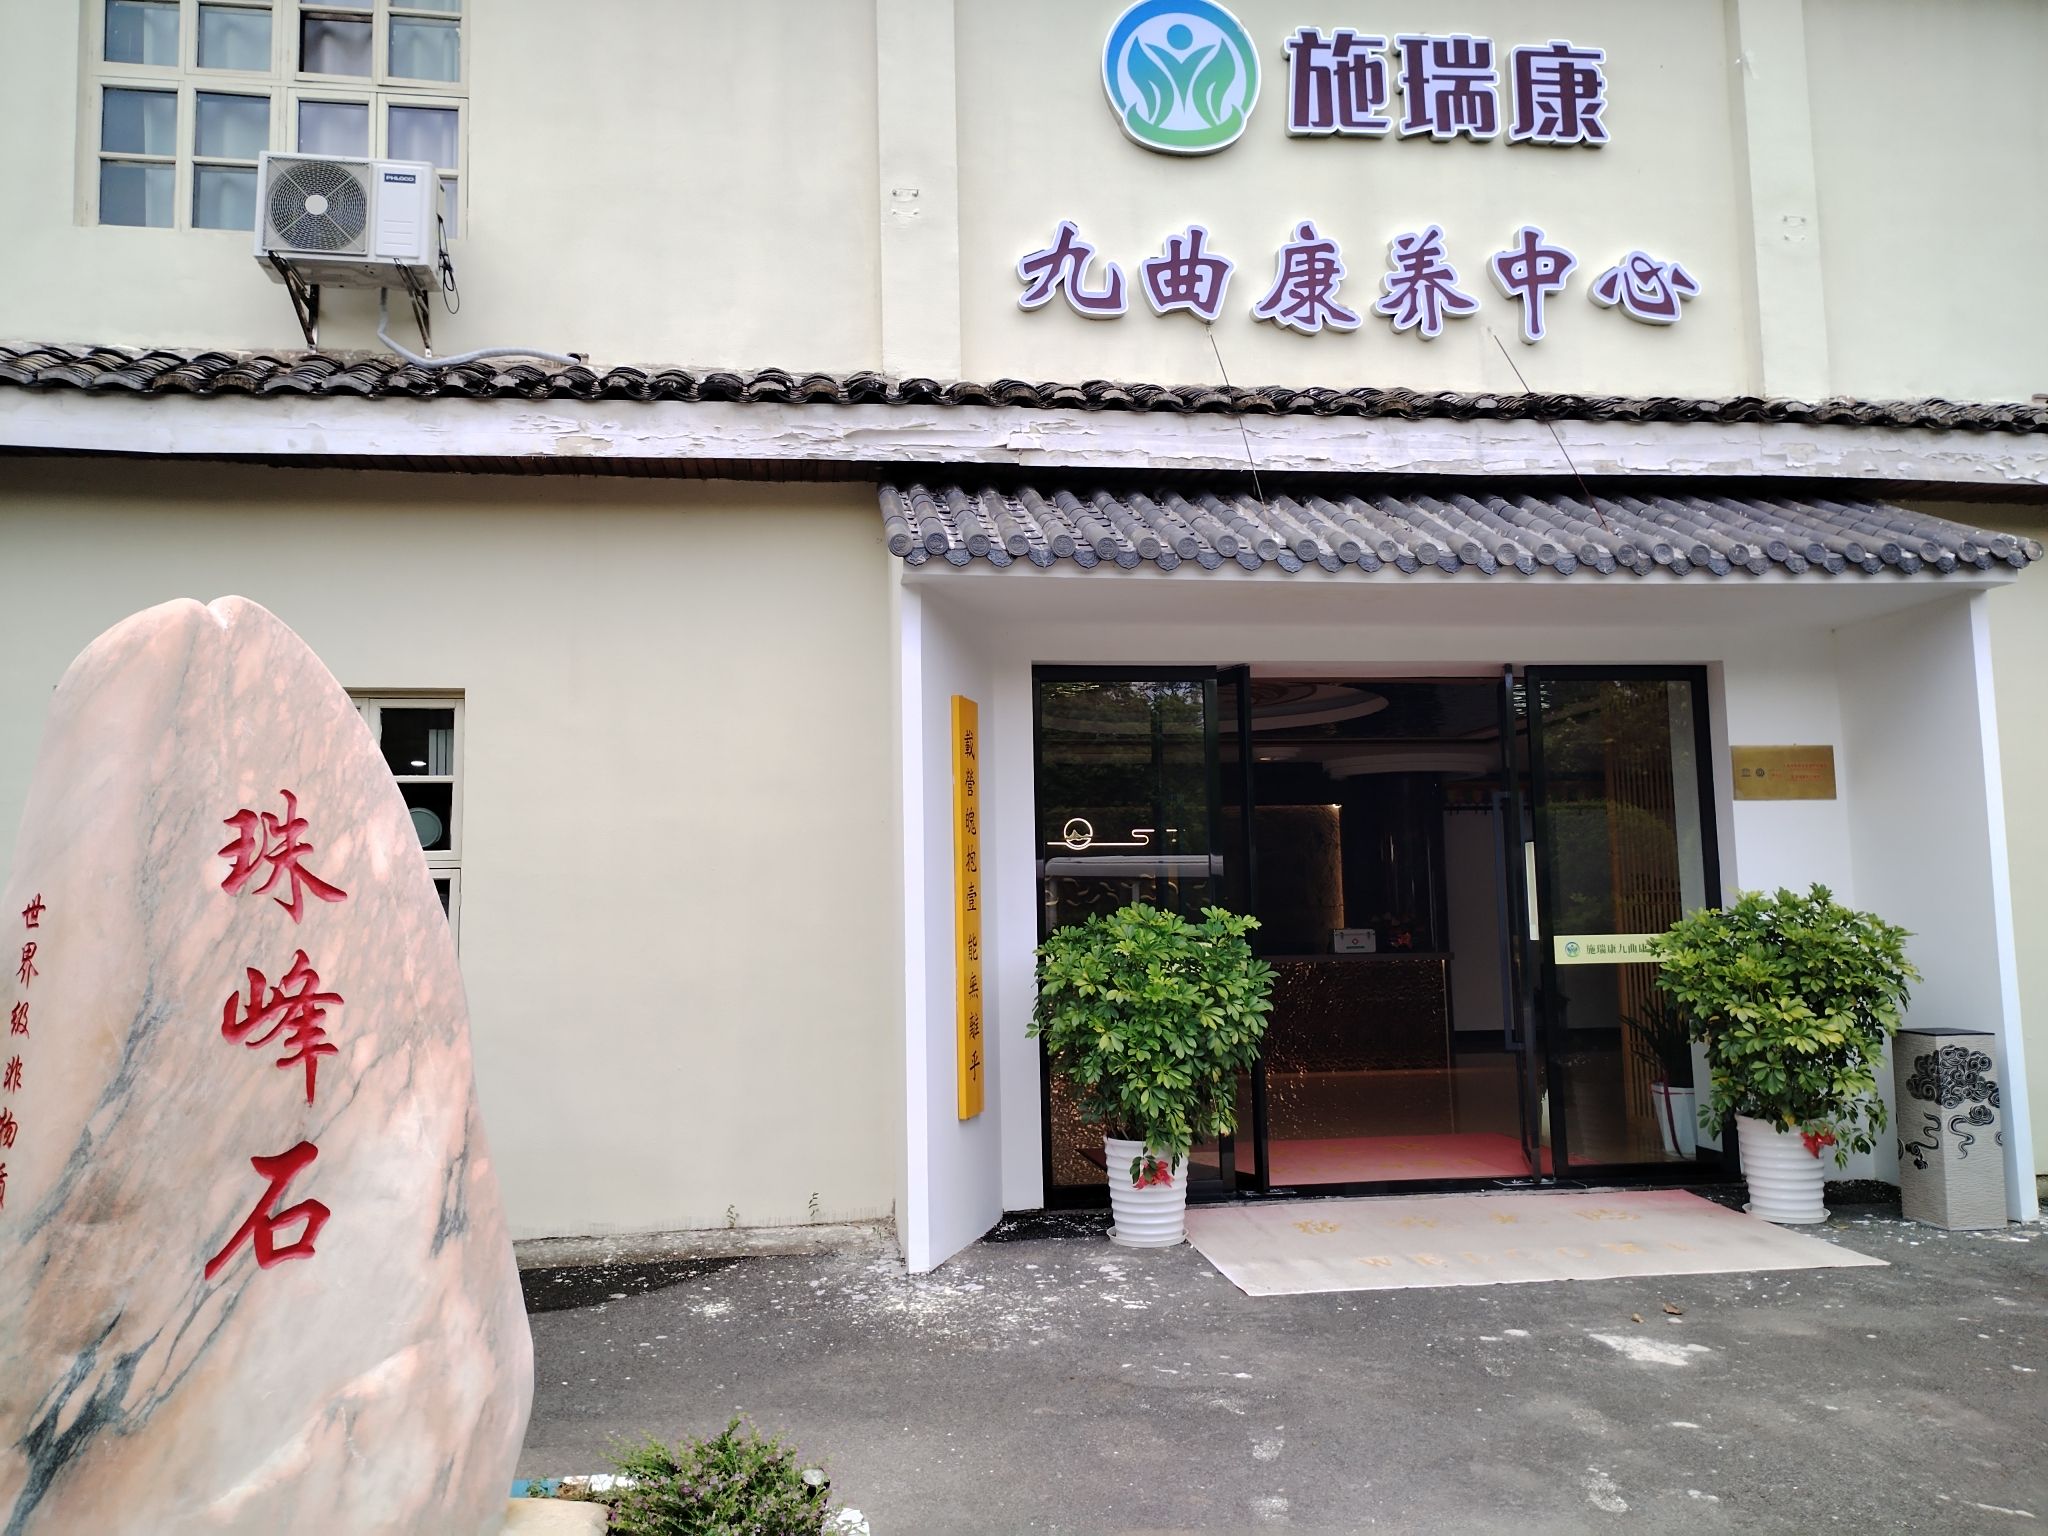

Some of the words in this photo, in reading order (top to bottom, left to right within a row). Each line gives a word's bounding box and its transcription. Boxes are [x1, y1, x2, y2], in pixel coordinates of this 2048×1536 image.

[1287, 29, 1609, 143] 施瑞康
[1018, 222, 1699, 340] 九曲康养中心
[1586, 943, 1655, 955] 施瑞康九曲康
[204, 789, 347, 1280] 珠峰石
